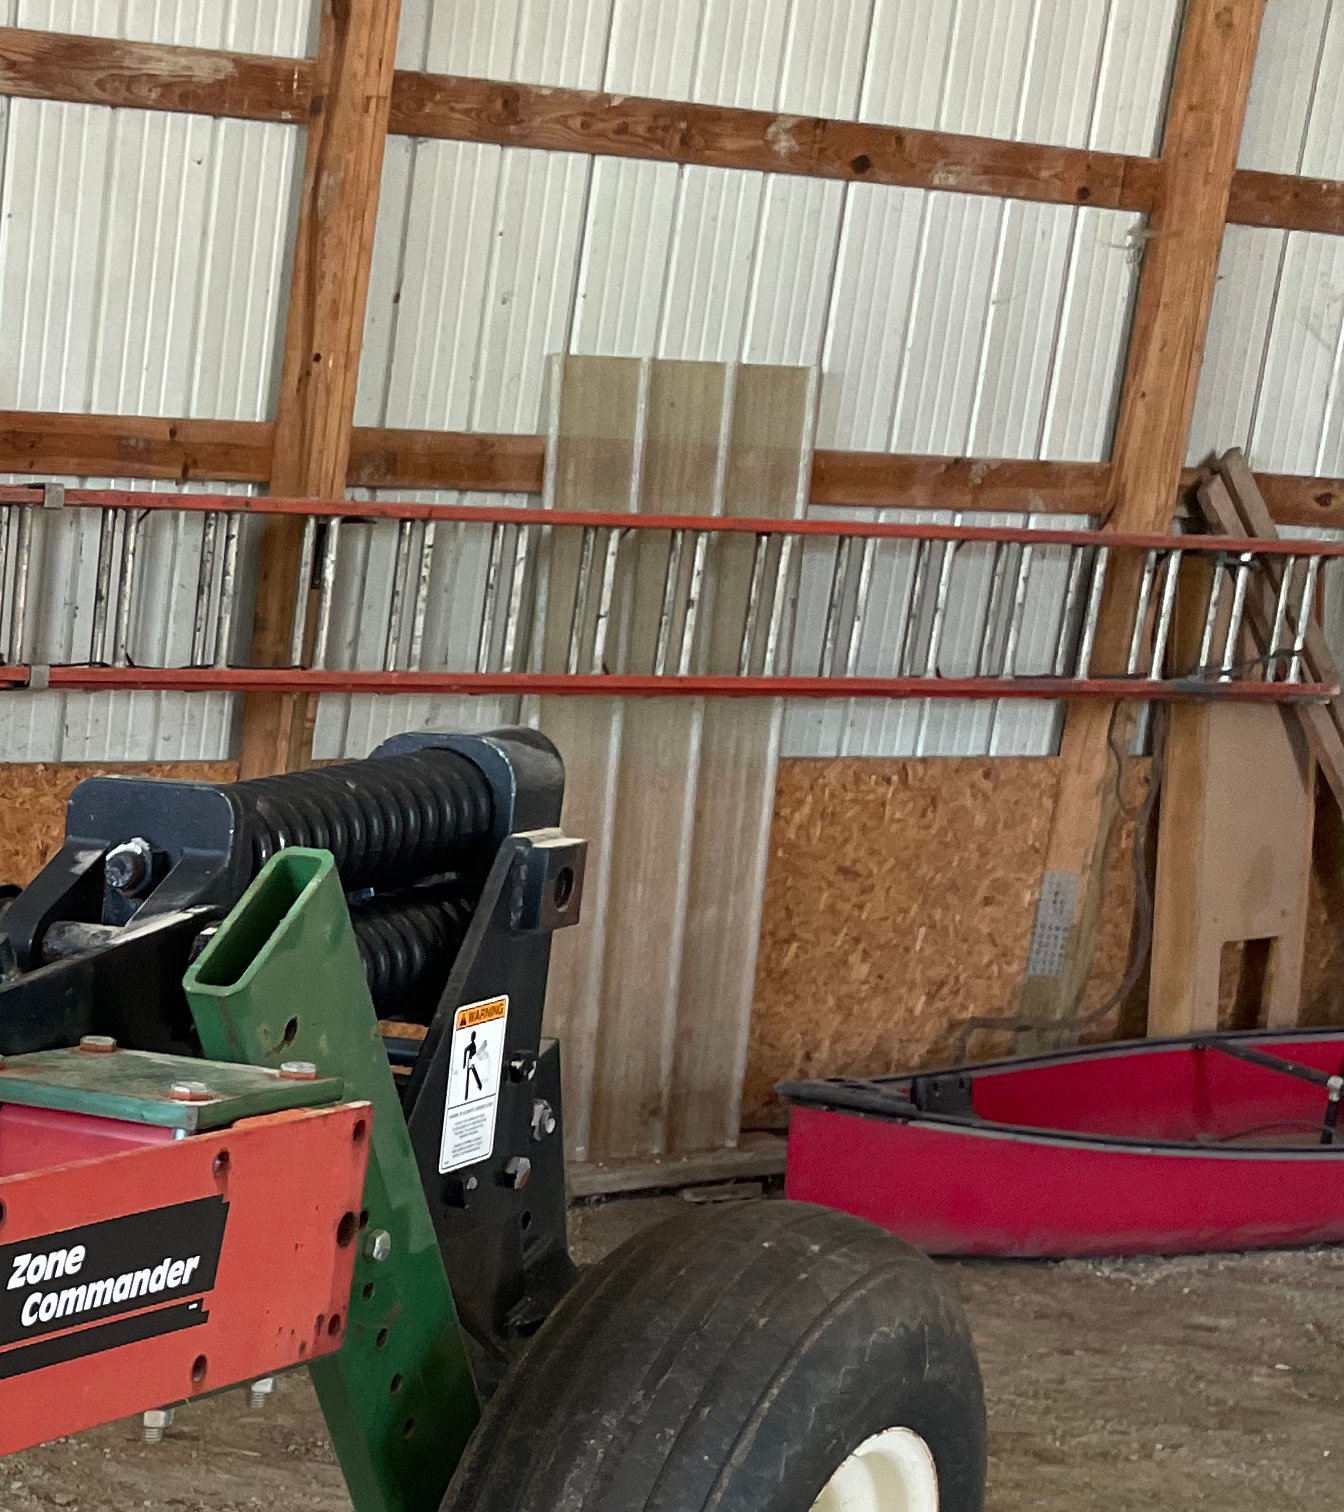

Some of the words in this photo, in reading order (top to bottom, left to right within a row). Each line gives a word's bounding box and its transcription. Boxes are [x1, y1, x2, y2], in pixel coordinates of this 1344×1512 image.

[469, 1003, 504, 1023] WARNING
[6, 1245, 86, 1290] Zone
[21, 1255, 202, 1327] Commander
